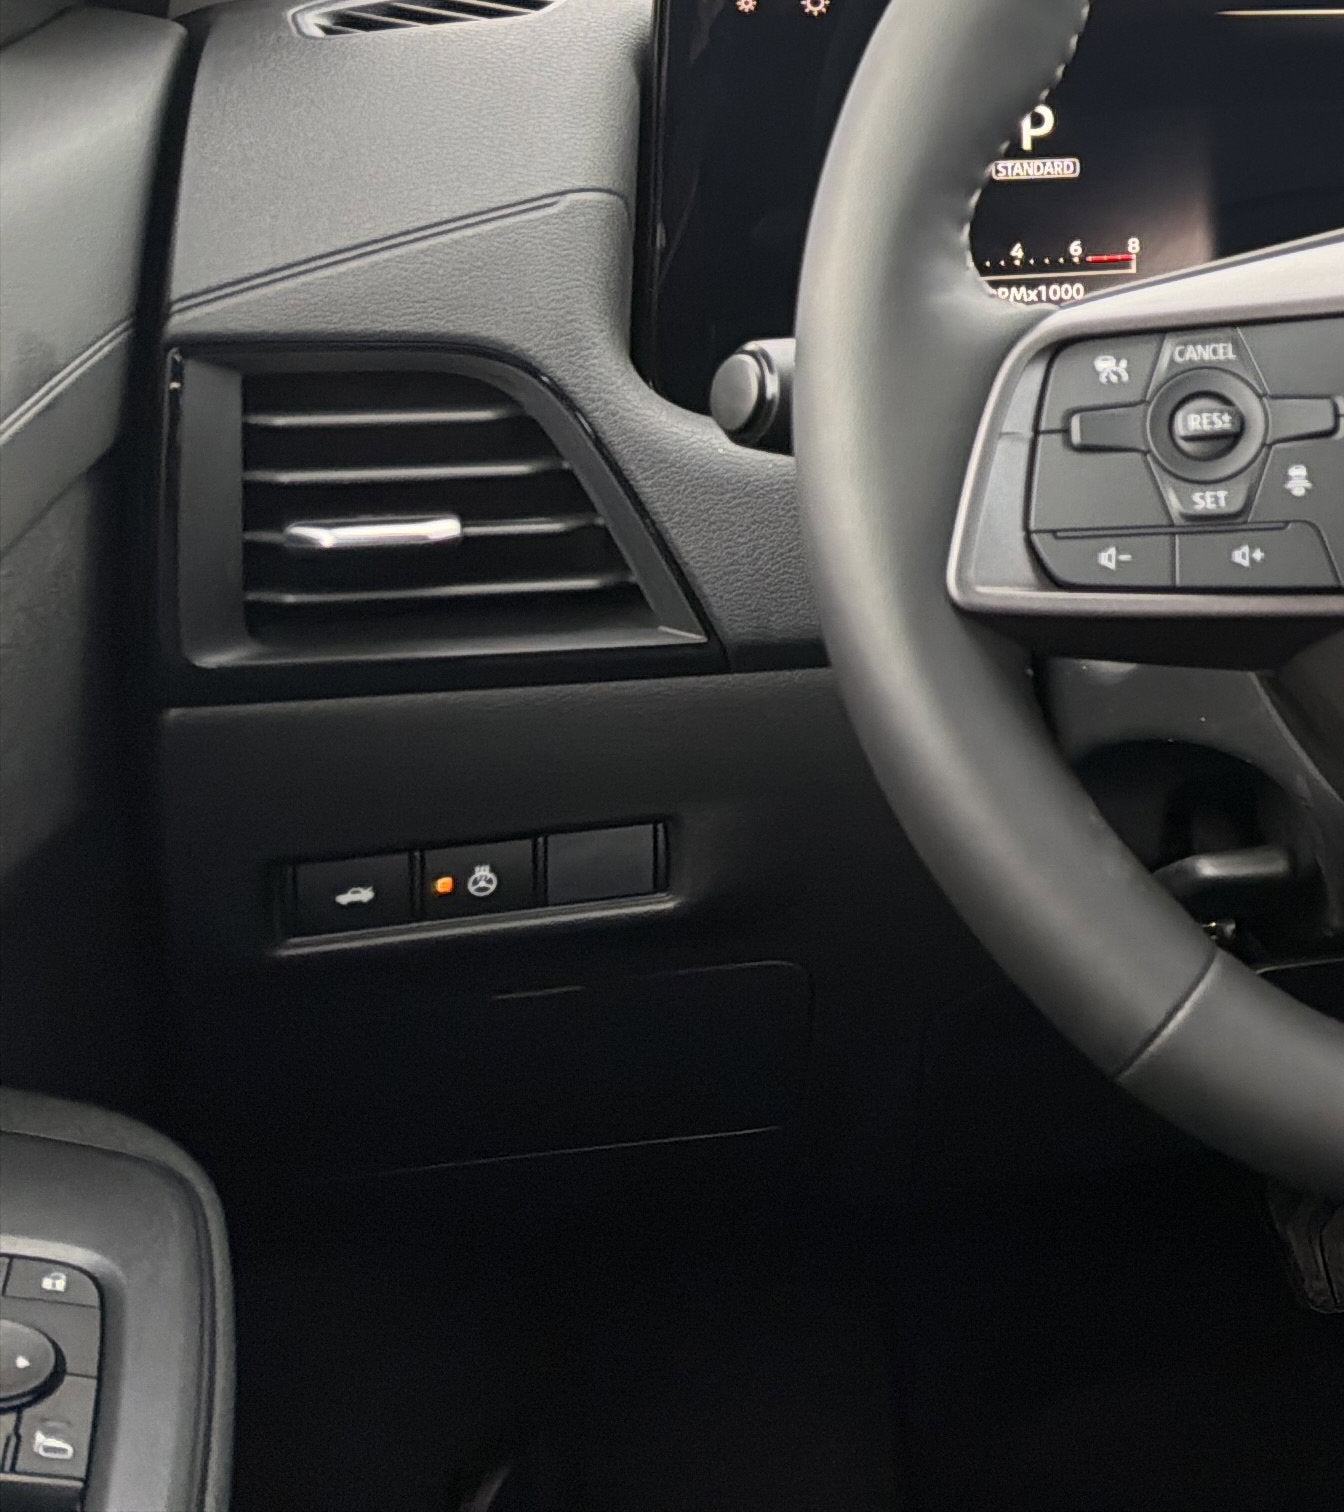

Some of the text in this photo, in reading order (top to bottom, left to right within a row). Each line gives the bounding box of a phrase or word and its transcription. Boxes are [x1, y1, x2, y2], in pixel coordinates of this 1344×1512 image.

[1021, 103, 1055, 151] P
[996, 161, 1075, 177] STANDARD
[1010, 238, 1140, 259] 4 6 8
[990, 283, 1085, 303] PMx1000
[1173, 343, 1237, 363] CANCEL
[1191, 490, 1229, 510] SET
